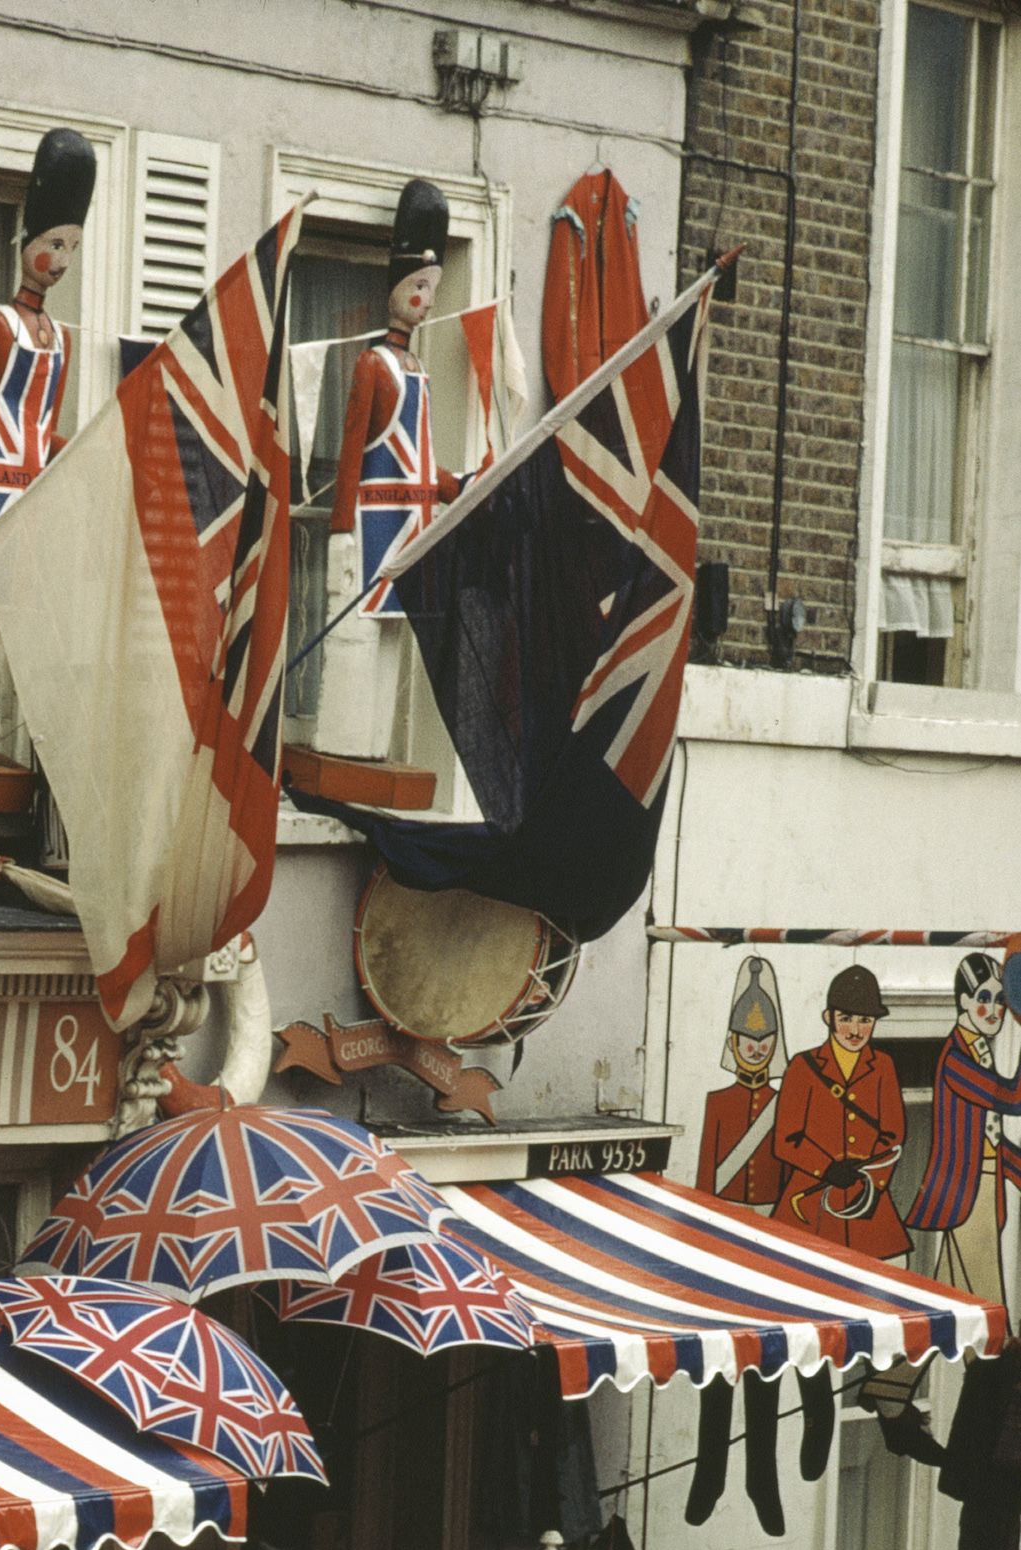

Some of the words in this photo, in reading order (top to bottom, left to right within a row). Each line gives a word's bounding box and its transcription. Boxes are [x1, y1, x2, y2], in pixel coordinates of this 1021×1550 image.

[49, 1014, 102, 1108] 84
[548, 1143, 595, 1171] PARK
[601, 1139, 647, 1172] 9535
